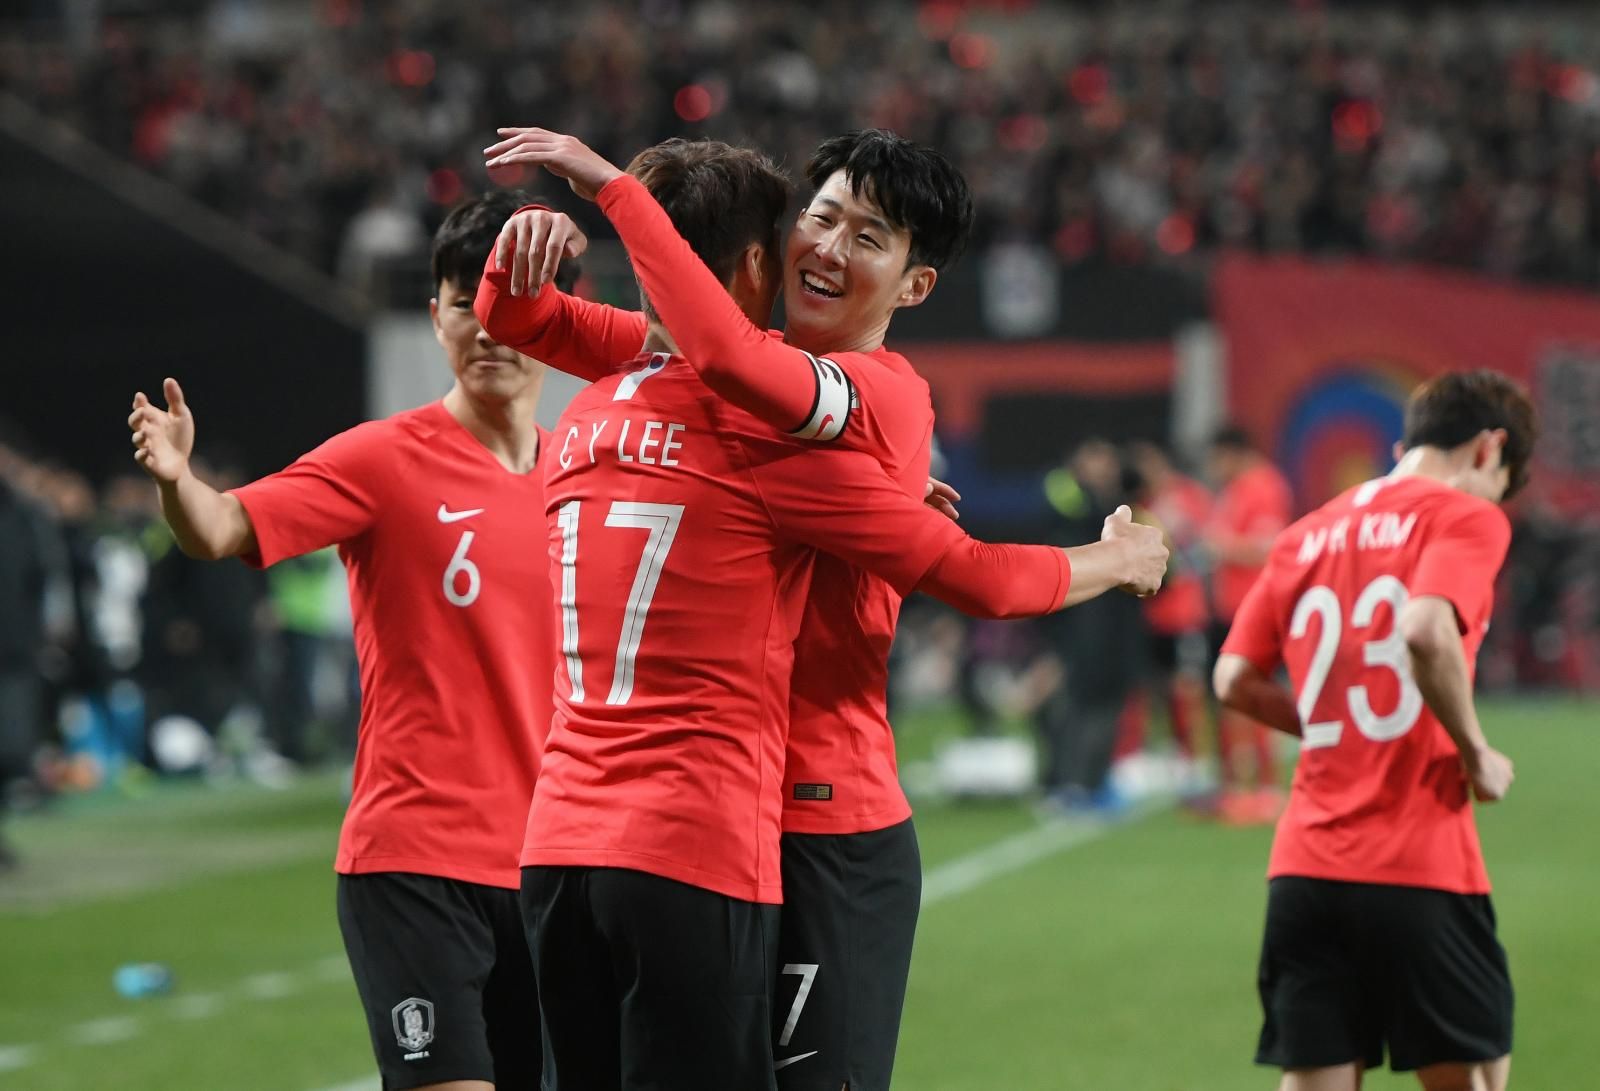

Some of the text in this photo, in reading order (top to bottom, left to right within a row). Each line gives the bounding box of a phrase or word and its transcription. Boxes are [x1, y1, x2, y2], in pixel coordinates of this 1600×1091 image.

[559, 419, 686, 470] C Y LEE
[442, 531, 481, 608] 6
[1357, 511, 1418, 550] KIM
[557, 500, 686, 706] 17
[1290, 574, 1424, 750] 23
[778, 963, 819, 1047] 7
